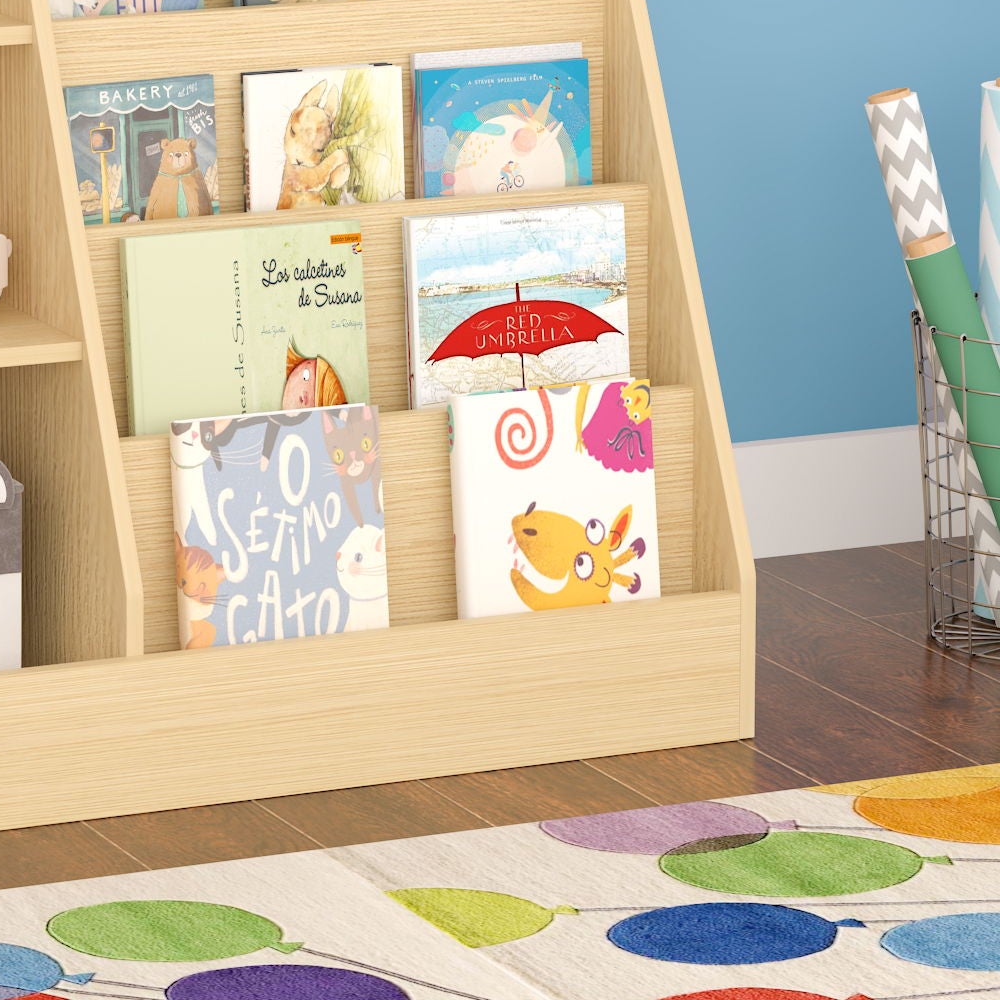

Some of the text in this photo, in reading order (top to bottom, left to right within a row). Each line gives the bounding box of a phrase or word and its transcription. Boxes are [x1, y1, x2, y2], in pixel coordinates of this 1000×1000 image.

[99, 84, 174, 106] BAKERY
[261, 258, 347, 287] Los calcetines
[232, 259, 244, 345] Susana
[298, 283, 363, 308] de Susana
[514, 304, 531, 313] THE
[505, 313, 541, 330] RED
[475, 326, 574, 350] UMBRELLA
[234, 353, 245, 379] de
[278, 434, 311, 506] O
[226, 570, 341, 645] GATO
